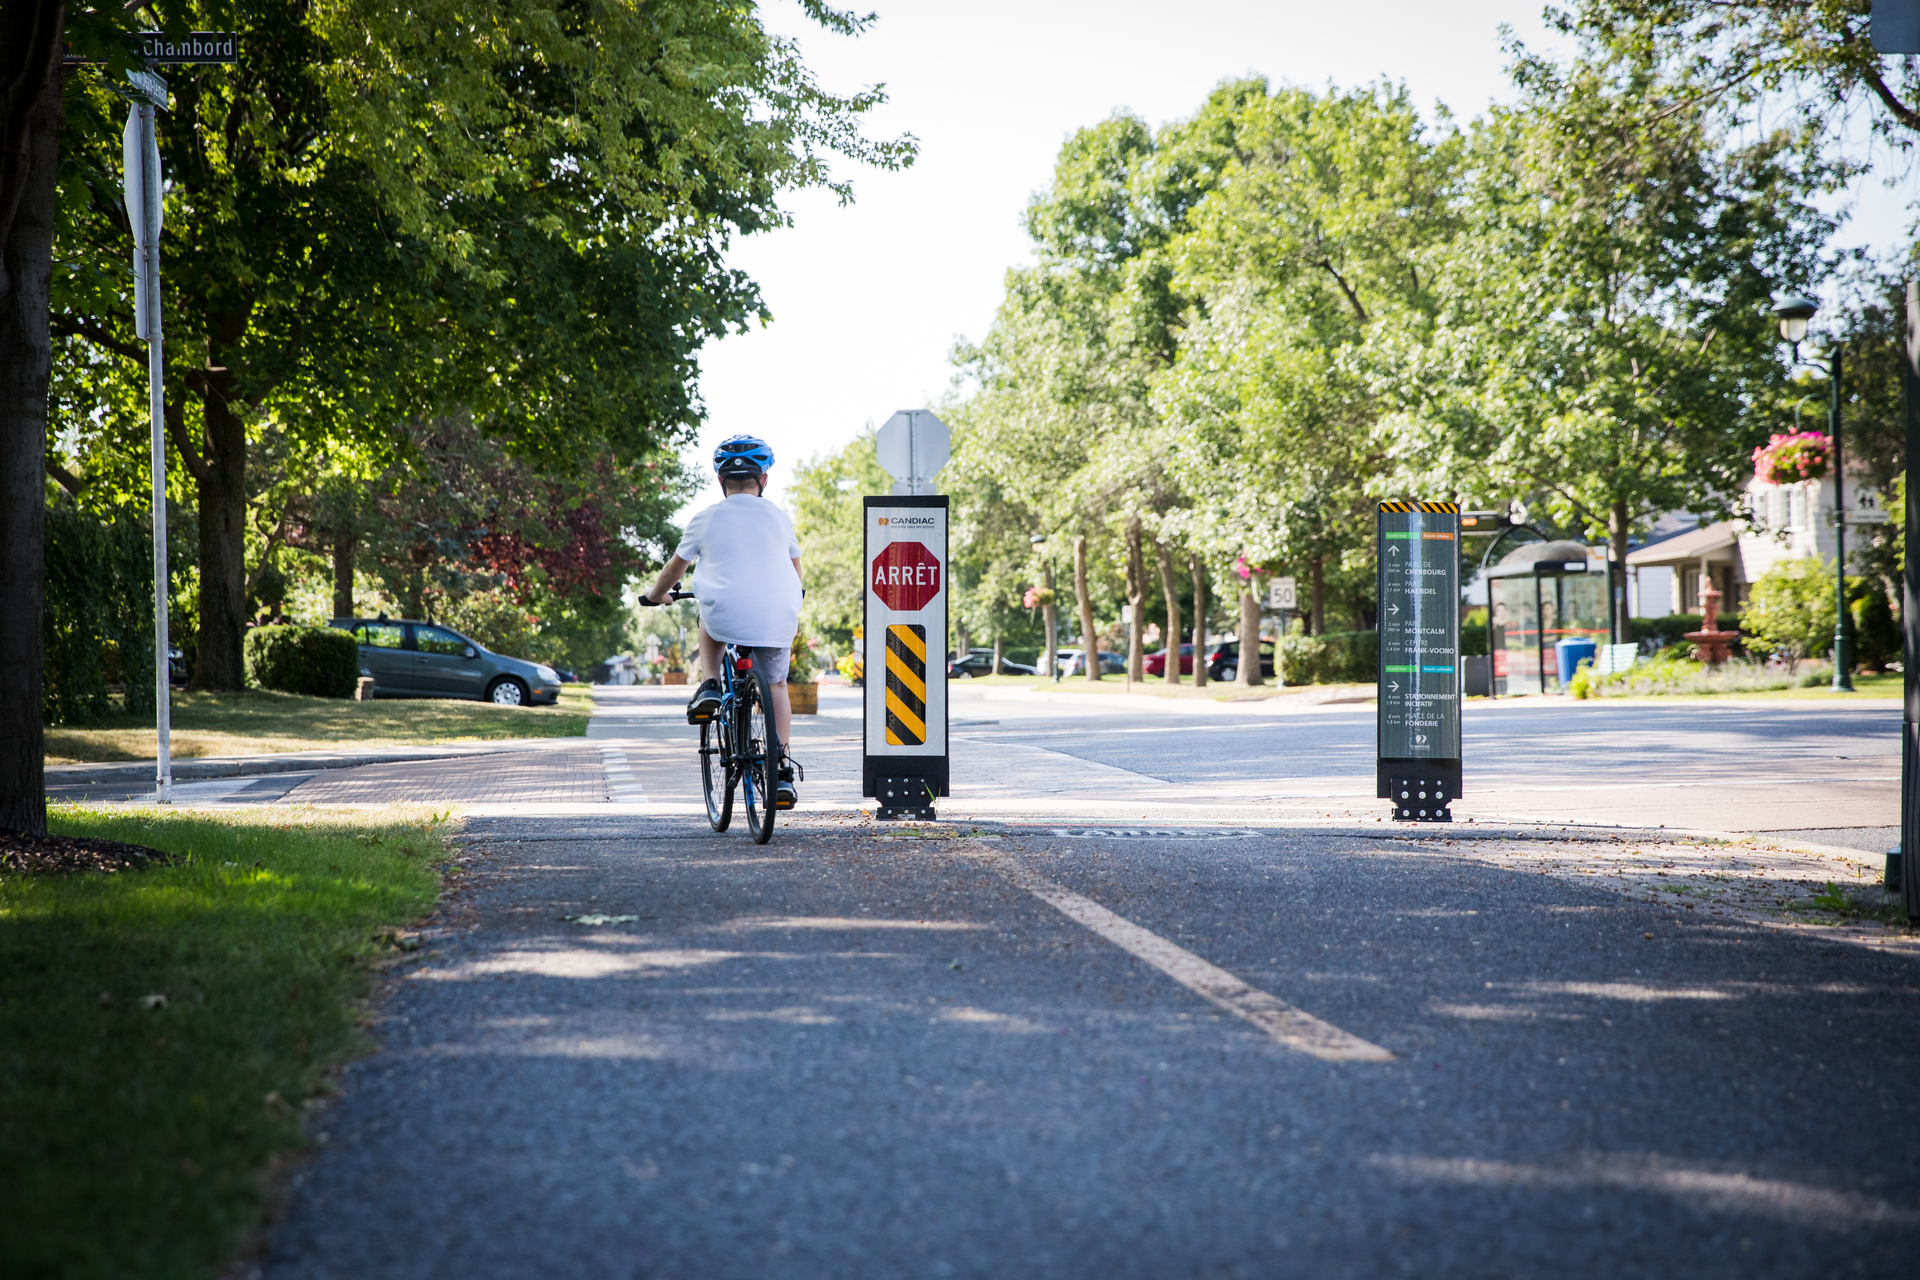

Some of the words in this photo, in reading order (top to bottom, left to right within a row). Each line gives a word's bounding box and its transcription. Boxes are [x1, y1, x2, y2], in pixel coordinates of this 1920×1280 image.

[143, 38, 232, 56] Chambord
[874, 562, 938, 585] ARRÊT
[1274, 587, 1293, 603] 50
